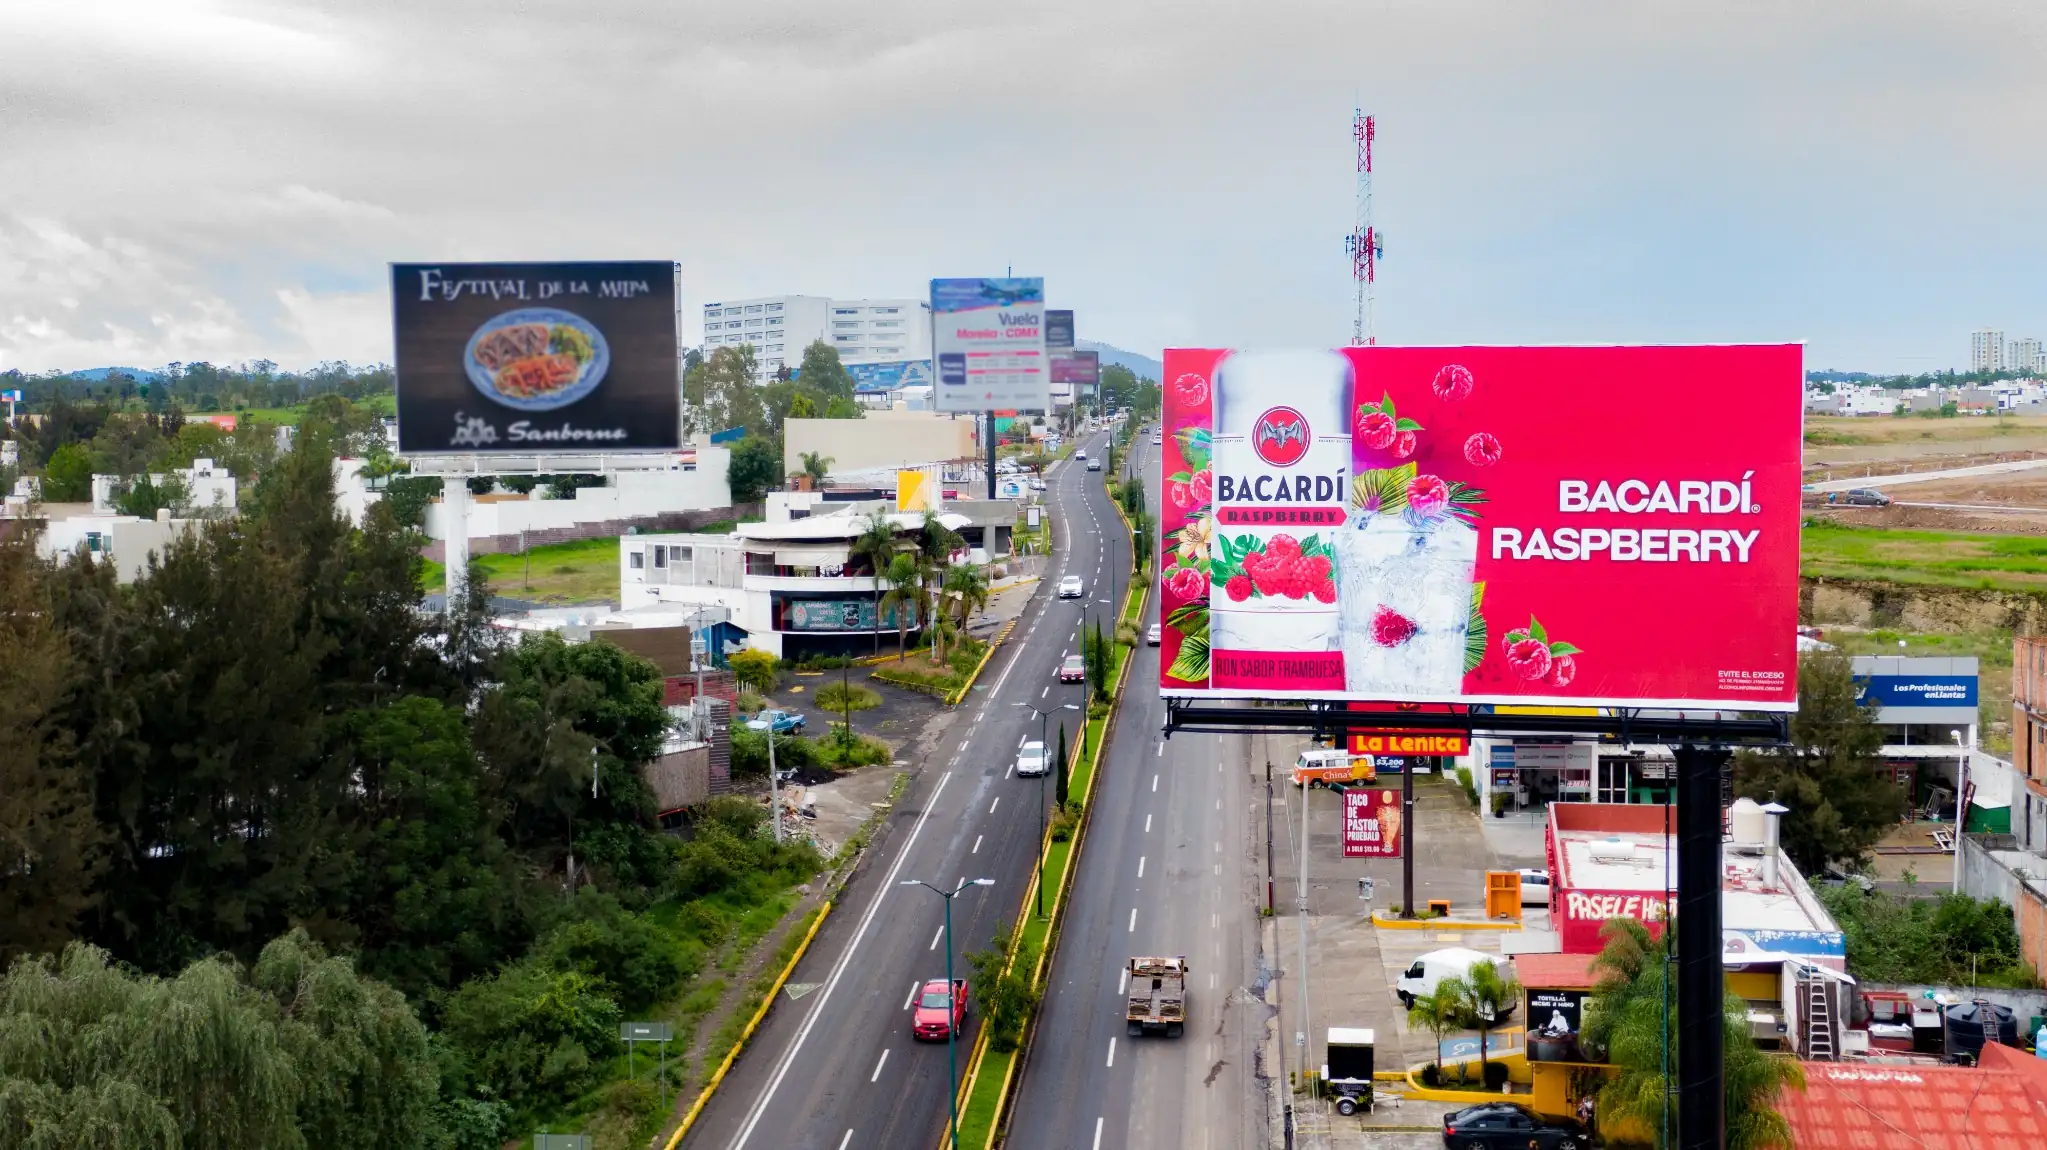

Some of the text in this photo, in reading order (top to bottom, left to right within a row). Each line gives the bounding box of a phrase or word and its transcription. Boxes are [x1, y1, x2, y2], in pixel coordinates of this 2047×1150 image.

[539, 281, 563, 300] DE
[570, 281, 590, 294] LA
[598, 280, 649, 299] MILPA
[998, 312, 1039, 326] Vuela
[1005, 328, 1040, 339] CDMX
[507, 420, 627, 441] Sanborns
[1218, 467, 1346, 501] BACARDÍ
[1559, 470, 1755, 514] BACARDÍ
[1227, 511, 1337, 522] RASPBERRY
[1492, 527, 1760, 562] RASPBERRY
[1216, 658, 1345, 678] RON SABOR FRAMBUESA
[1718, 670, 1740, 678] EVITE
[1752, 671, 1784, 679] EXCESO
[1894, 684, 1966, 692] Los Profesionales
[1356, 734, 1383, 752] La
[1323, 770, 1353, 779] China's
[1346, 794, 1368, 806] TACO
[1347, 806, 1358, 818] DE
[1347, 819, 1378, 831] PASTOR
[1567, 892, 1641, 920] PASELE
